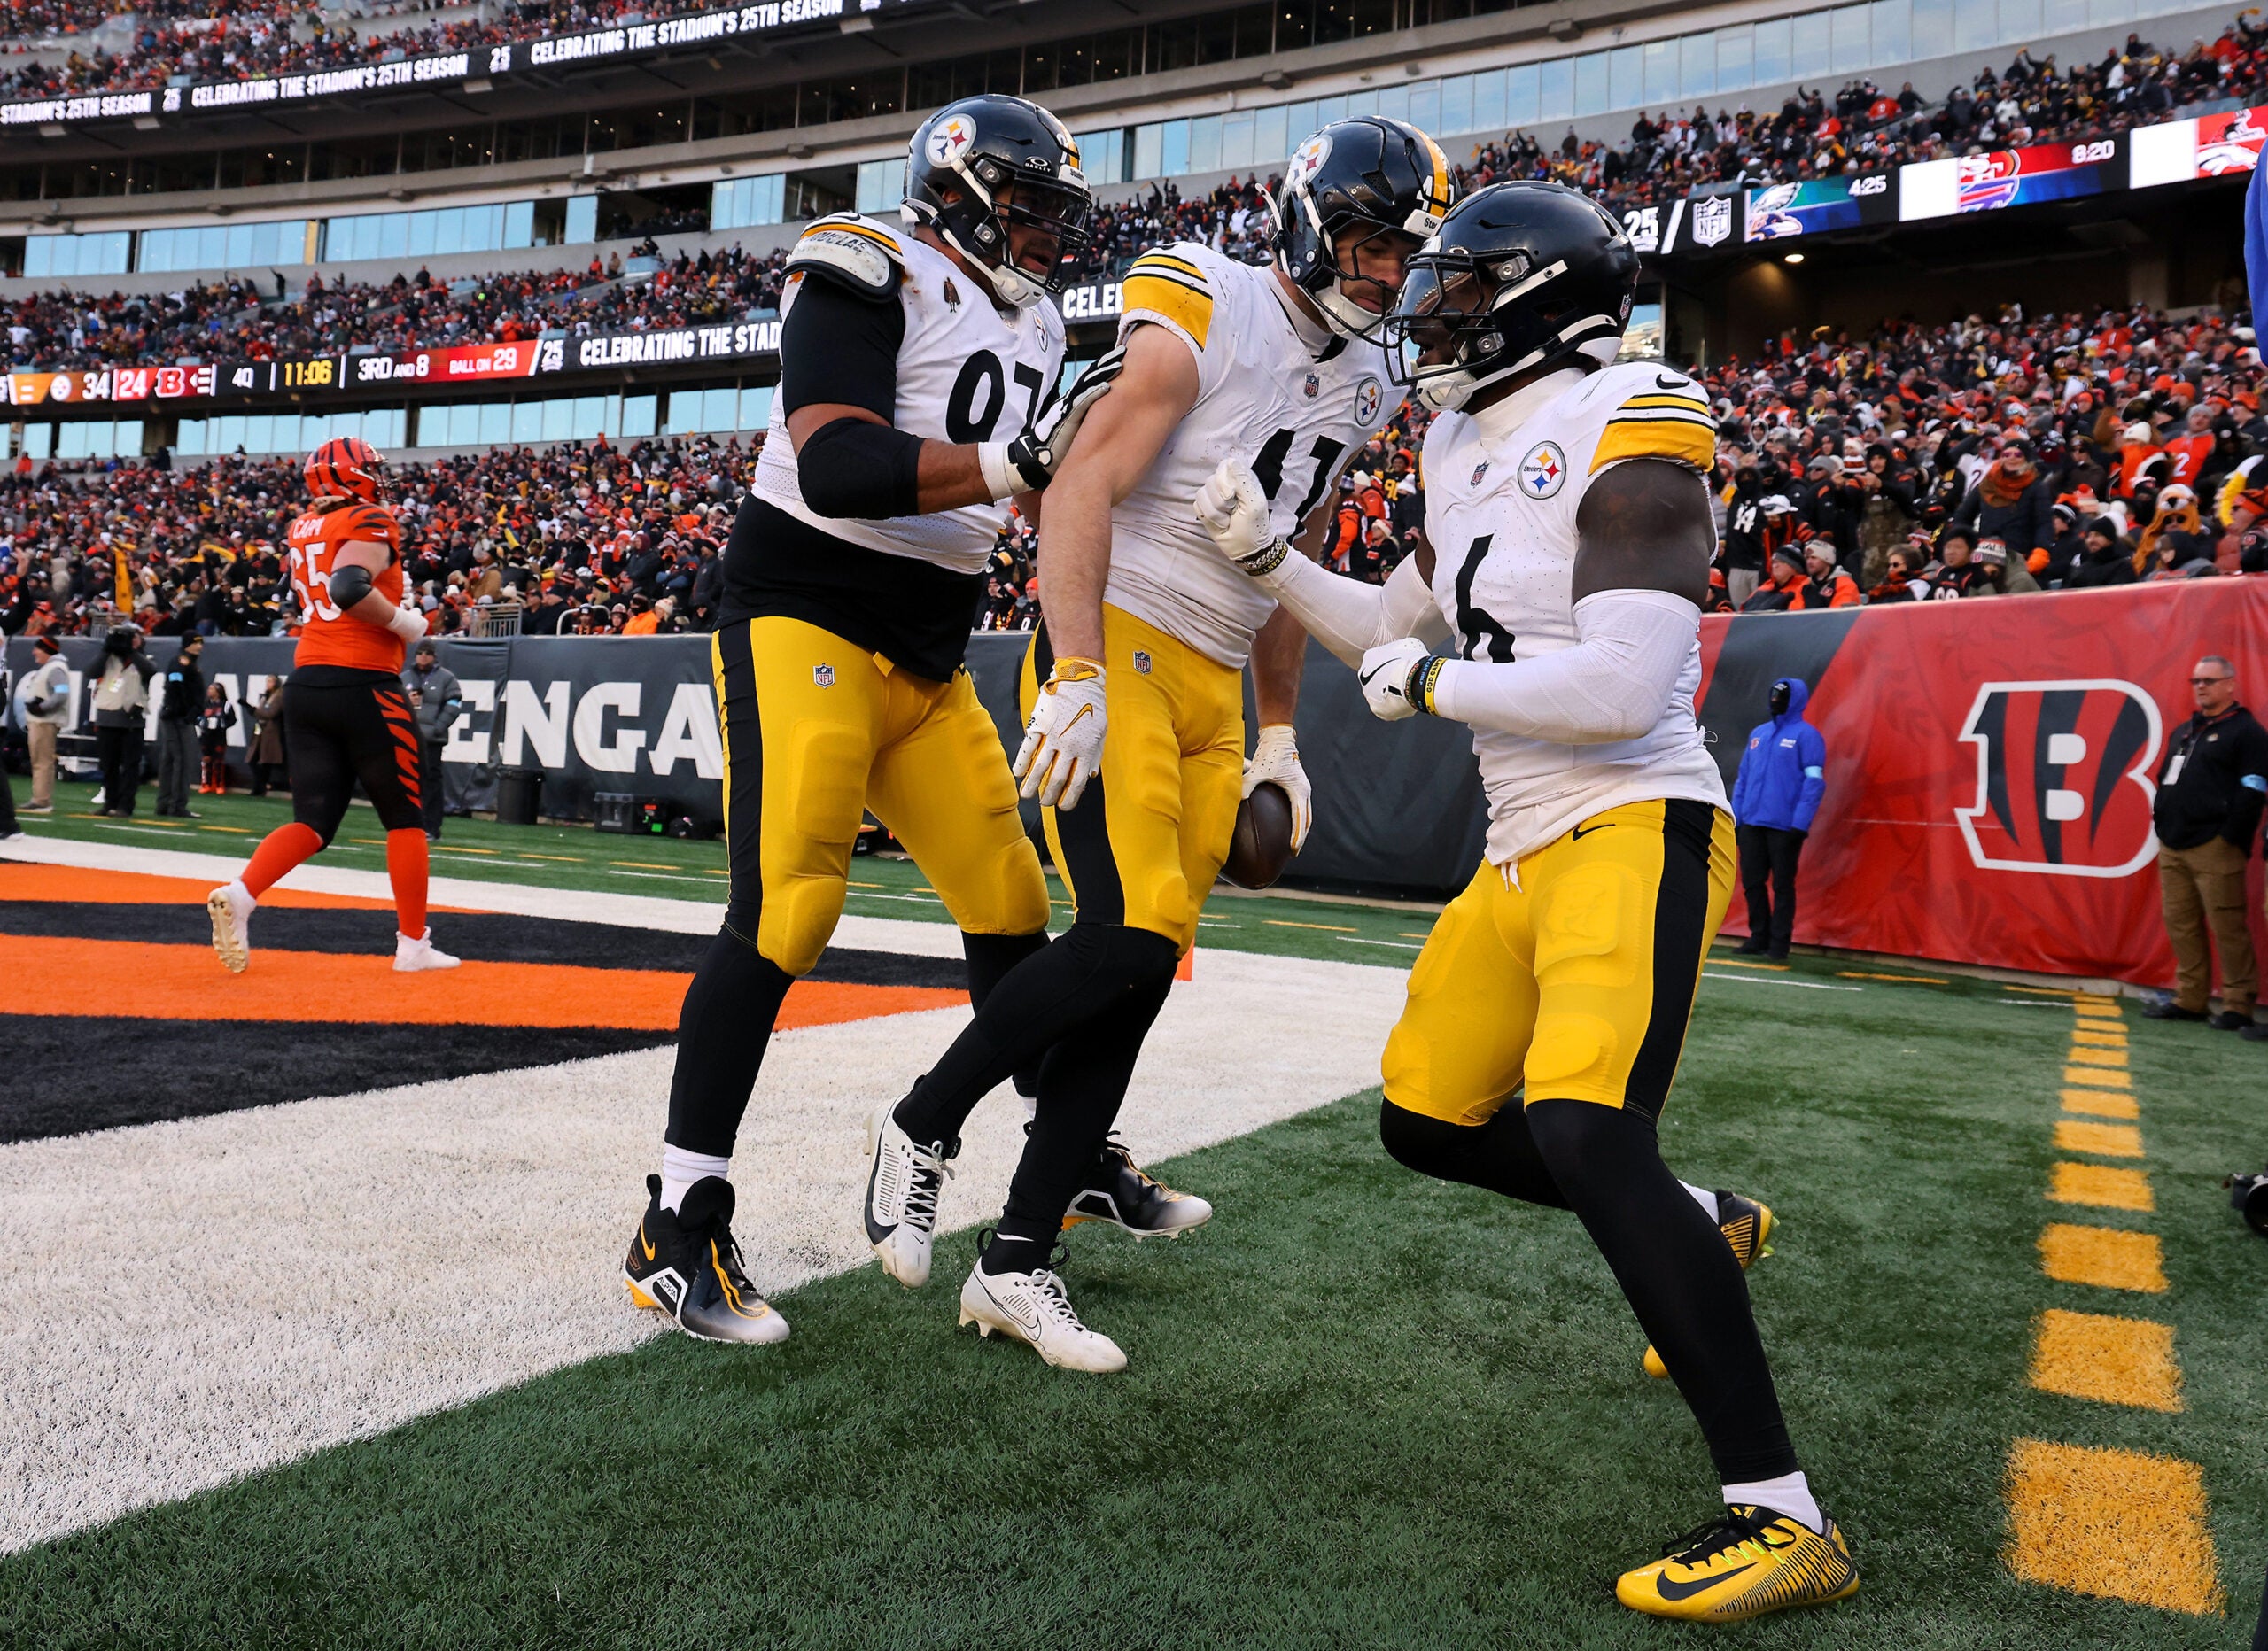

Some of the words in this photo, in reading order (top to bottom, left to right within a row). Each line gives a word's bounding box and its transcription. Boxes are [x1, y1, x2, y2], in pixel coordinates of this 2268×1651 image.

[531, 30, 625, 65] CELEBRATING
[627, 24, 656, 50] THE
[657, 12, 737, 44] STADIUM'S
[739, 4, 780, 32] 25TH
[781, 0, 843, 23] SEASON
[490, 46, 510, 66] 25
[191, 79, 278, 107] CELEBRATING
[279, 74, 307, 98] THE
[307, 66, 377, 95] STADIUM'S
[377, 61, 412, 86] 25TH
[414, 53, 469, 81] SEASON
[0, 101, 66, 124] STADIUM'S
[66, 97, 100, 119] 25TH
[101, 92, 151, 116] SEASON
[163, 89, 180, 105] 25
[2071, 140, 2115, 165] 8:20
[1848, 175, 1887, 197] 4:25
[1624, 207, 1658, 236] 25
[1698, 218, 1727, 238] NFL
[542, 339, 563, 362] 25
[580, 329, 695, 366] CELEBRATING
[698, 322, 732, 356] THE
[284, 360, 332, 387] 11:06
[357, 357, 392, 381] 3RD
[393, 364, 415, 378] AND
[416, 354, 430, 376] 8
[449, 359, 477, 375] BALL
[477, 357, 492, 373] ON
[493, 347, 517, 372] 29
[82, 372, 112, 399] 34
[119, 370, 148, 399] 24
[1429, 658, 1443, 676] CAN'T
[1425, 677, 1434, 693] GOD
[656, 1276, 678, 1300] ALPHA
